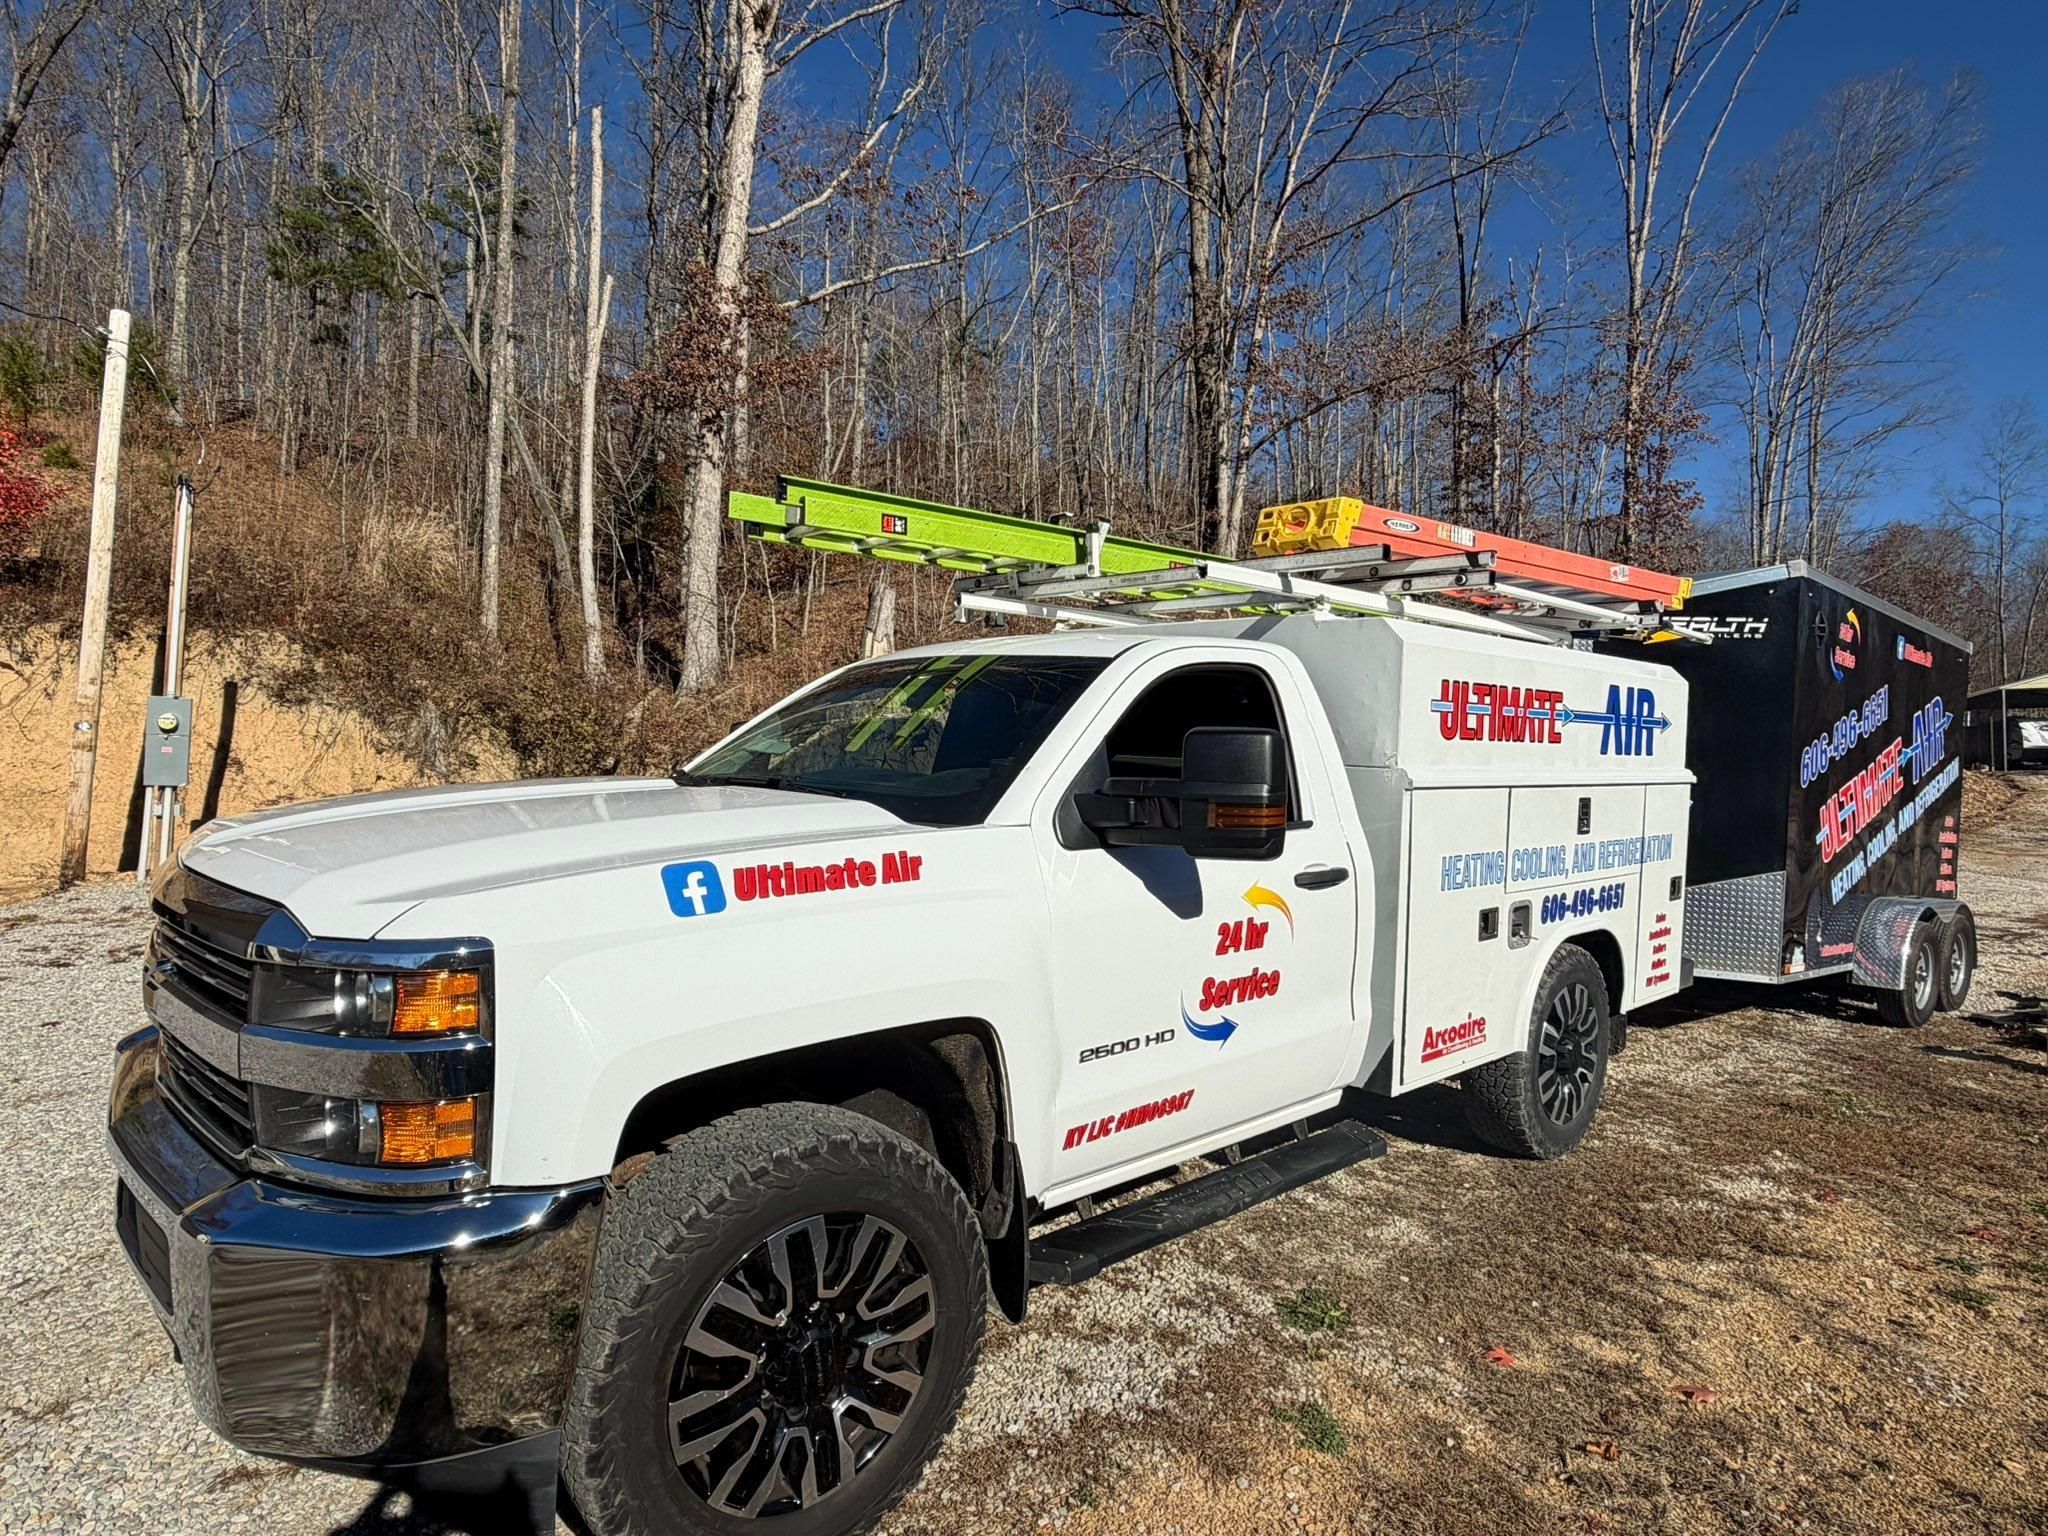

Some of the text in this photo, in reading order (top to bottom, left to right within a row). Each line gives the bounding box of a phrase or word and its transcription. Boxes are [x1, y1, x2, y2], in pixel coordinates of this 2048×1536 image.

[1391, 520, 1414, 530] WERNER
[1662, 616, 1769, 633] EALTH
[1439, 679, 1656, 756] ULTIMATE AIR
[1801, 684, 1889, 789] 606-496-6651
[1819, 696, 1946, 863] ULTIMATE AIR
[733, 857, 877, 901] Ultimate
[881, 851, 923, 884] Air
[1511, 845, 1569, 880] COOLING,
[1571, 841, 1596, 874] AND
[1598, 833, 1673, 871] REFRIGERATION
[1540, 882, 1626, 925] 606-496-6651
[1215, 917, 1269, 956] 24 hr
[1199, 967, 1281, 1012] Service
[1079, 1028, 1175, 1064] 2500 HD
[1421, 1011, 1486, 1053] Arcoaire
[1062, 1123, 1089, 1151] KY
[1086, 1115, 1115, 1143] LIC
